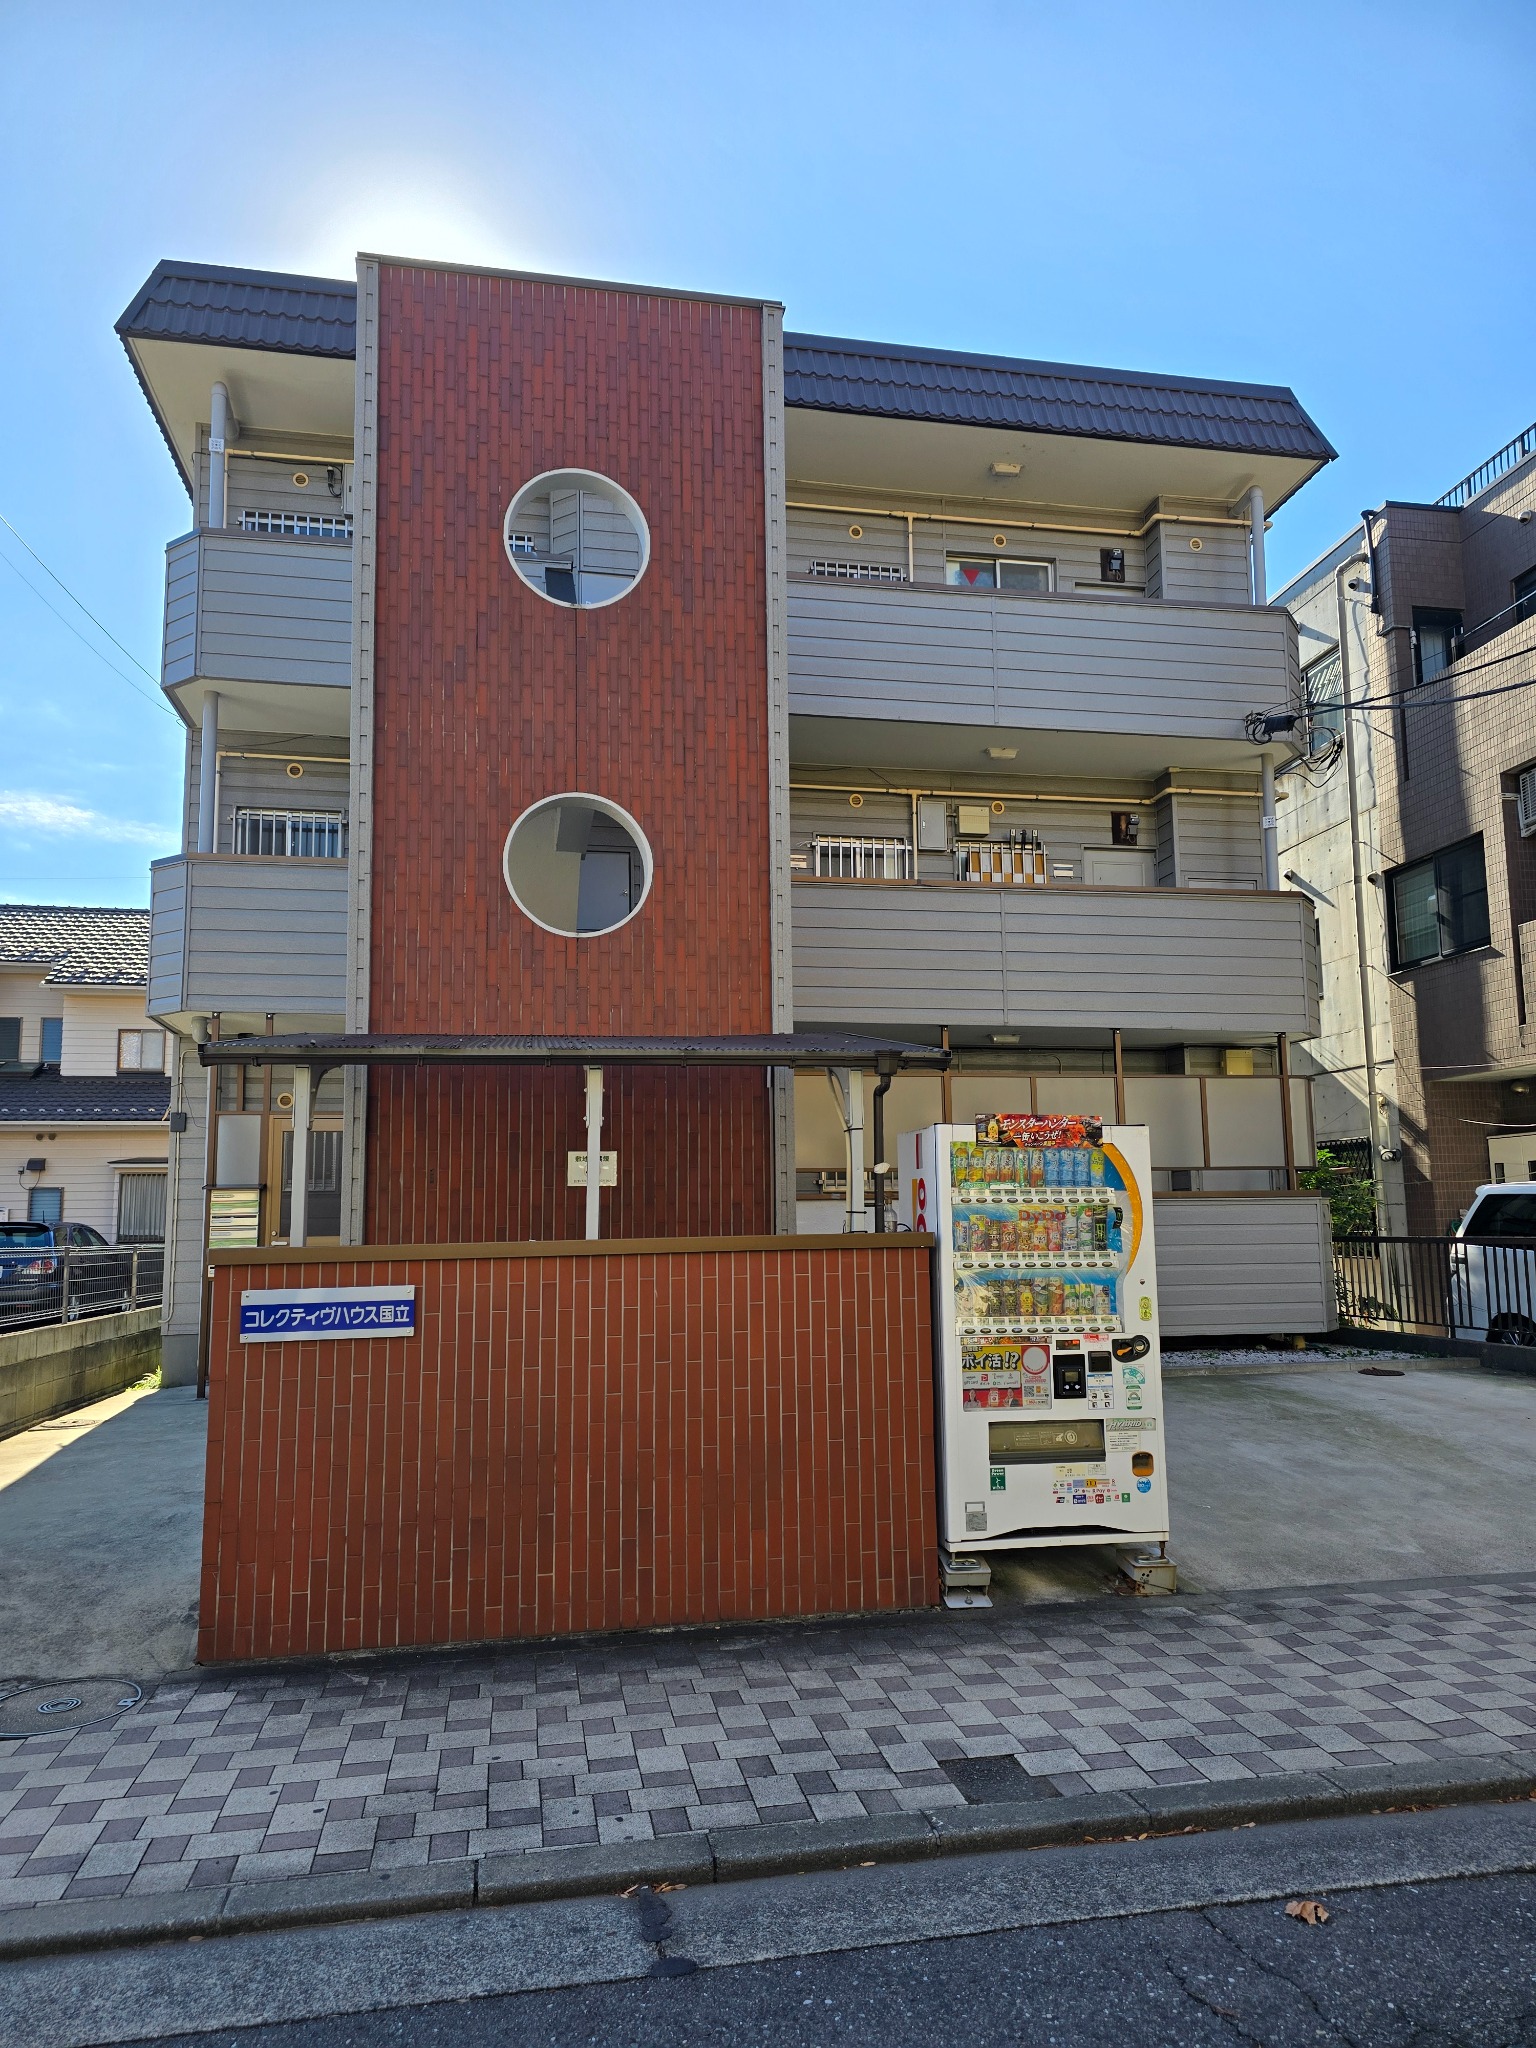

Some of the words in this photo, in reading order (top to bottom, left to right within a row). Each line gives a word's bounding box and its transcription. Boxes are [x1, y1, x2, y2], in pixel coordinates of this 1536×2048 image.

[1000, 1117, 1076, 1130] モンスターハンター
[1018, 1209, 1066, 1224] DyDo
[245, 1305, 410, 1328] コレクティヴハウス国立
[1109, 1421, 1142, 1431] HYBRID
